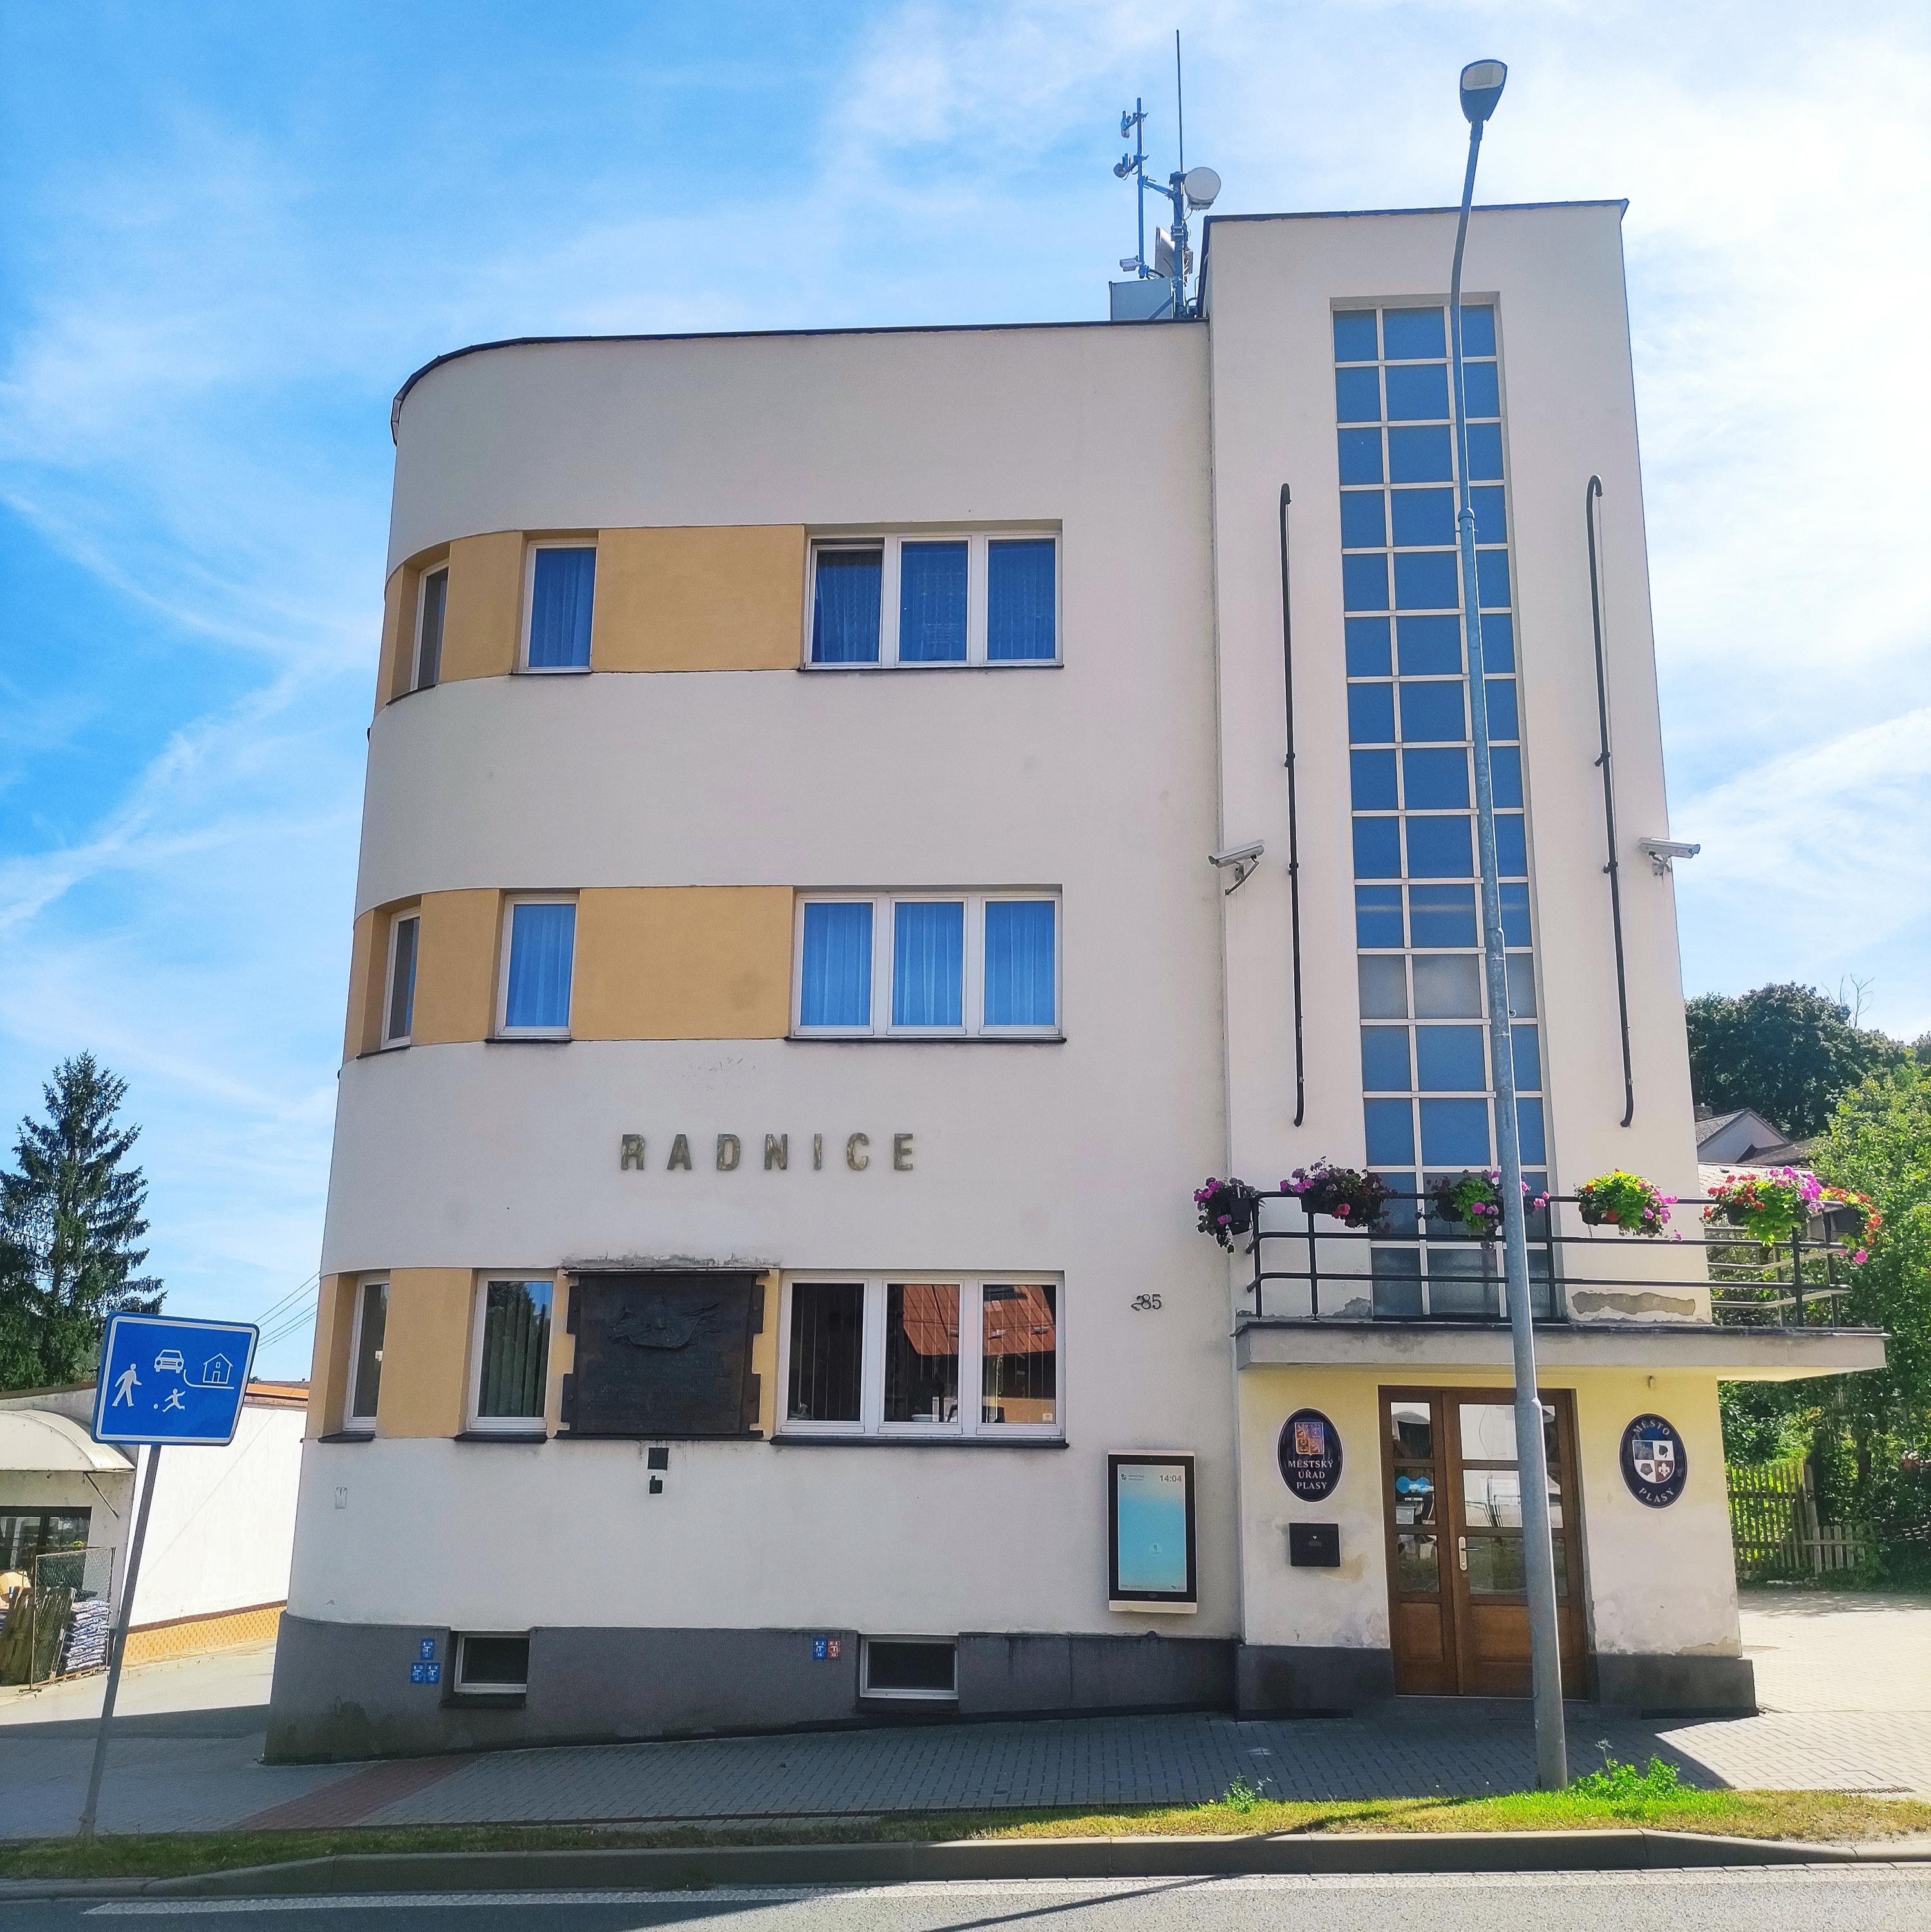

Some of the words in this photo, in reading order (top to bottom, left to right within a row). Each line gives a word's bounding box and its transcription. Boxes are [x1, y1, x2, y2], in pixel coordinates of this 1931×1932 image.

[620, 1132, 914, 1171] RADNICE
[1633, 1419, 1670, 1435] MĚSTO
[1288, 1459, 1334, 1468] MĚSTSKÝ
[1159, 1474, 1182, 1482] 14:04
[1298, 1470, 1325, 1479] ÚŘAD
[1639, 1487, 1674, 1503] PLASY
